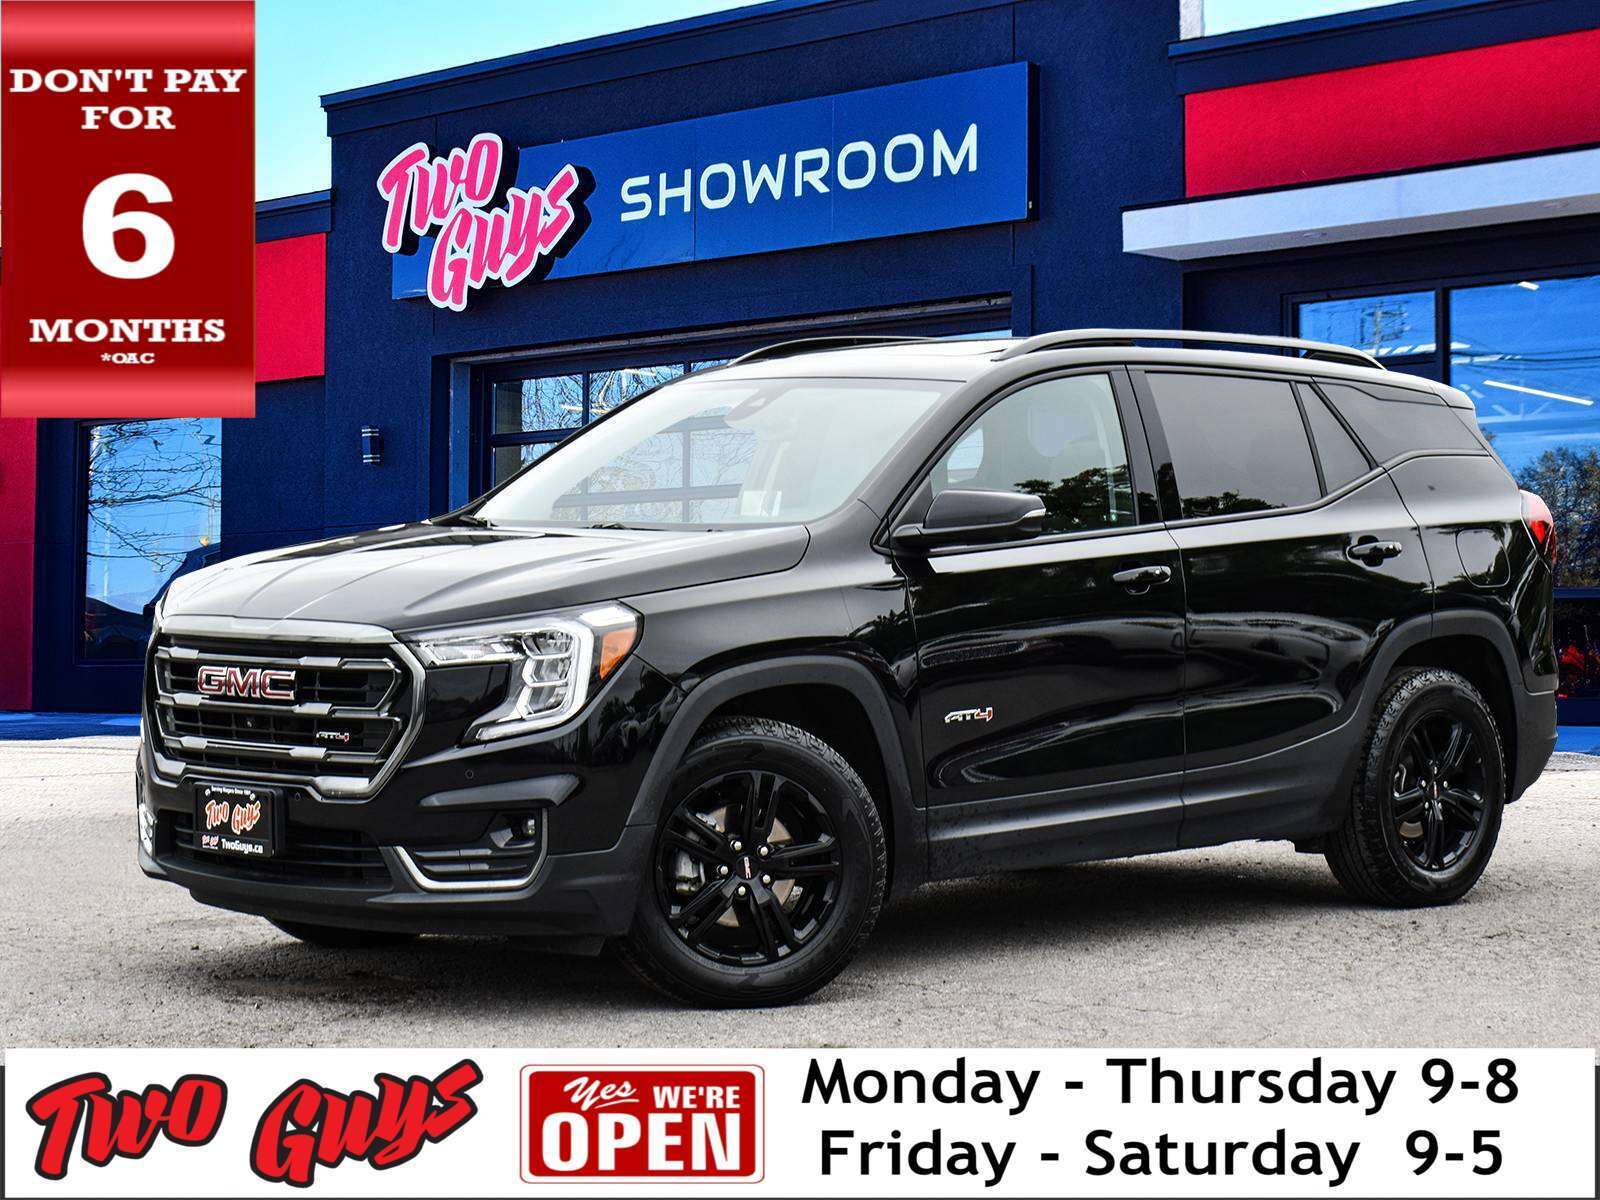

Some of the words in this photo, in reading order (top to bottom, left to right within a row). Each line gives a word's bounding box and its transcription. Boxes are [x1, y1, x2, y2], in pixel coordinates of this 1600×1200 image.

[621, 123, 977, 222] SHOWROOM
[377, 132, 503, 254] Two
[427, 164, 579, 311] Guys
[197, 665, 296, 700] GMC
[945, 707, 993, 723] AT4
[205, 800, 229, 829] Two
[231, 800, 261, 835] Guys
[221, 838, 264, 854] TwoGuys.ca
